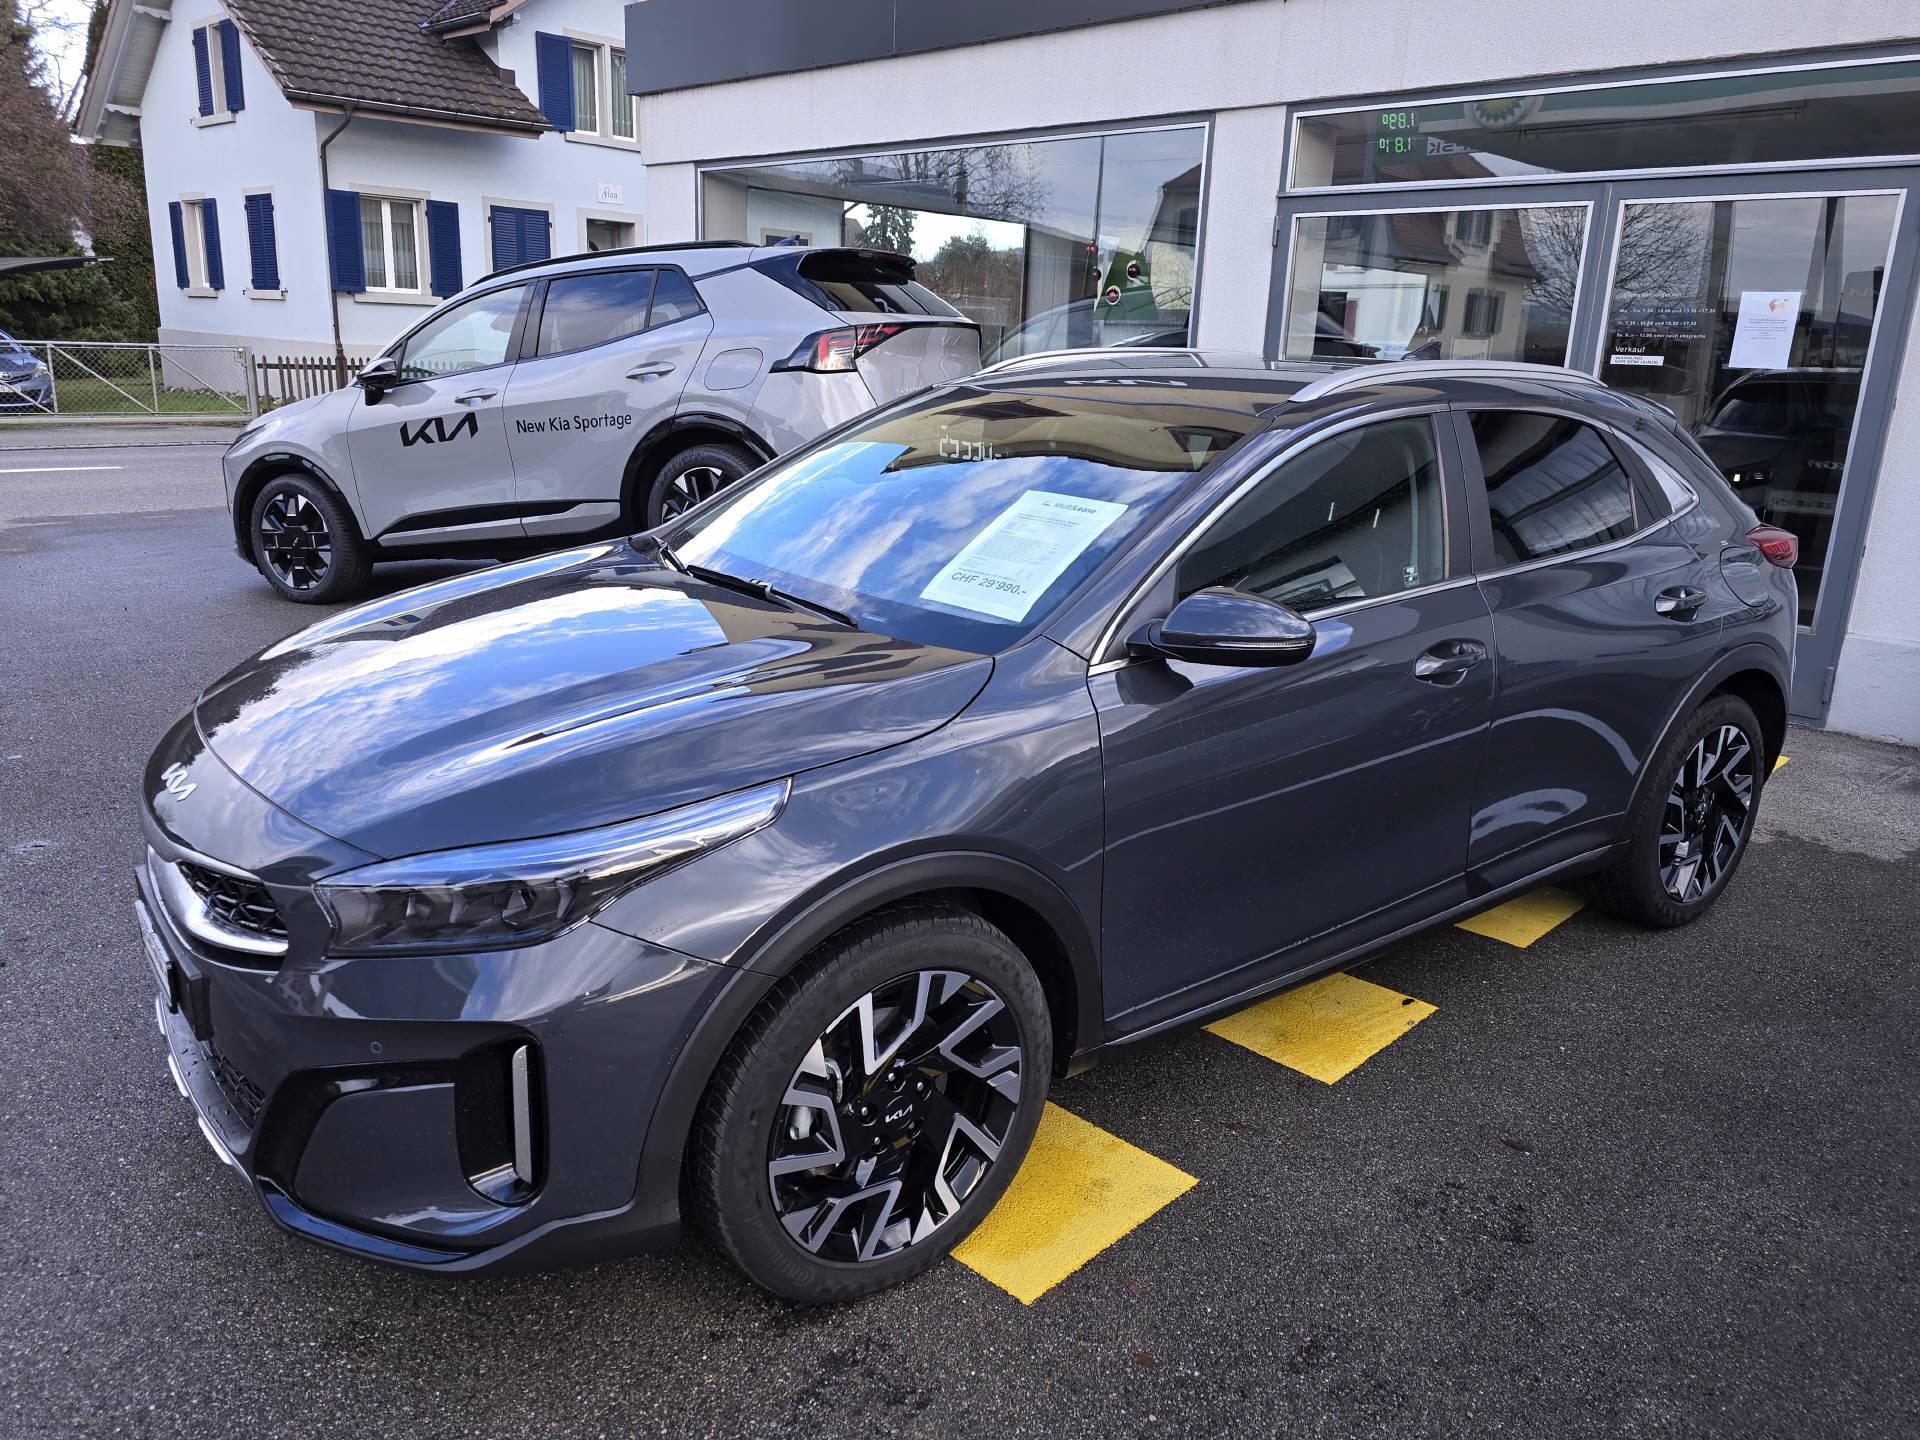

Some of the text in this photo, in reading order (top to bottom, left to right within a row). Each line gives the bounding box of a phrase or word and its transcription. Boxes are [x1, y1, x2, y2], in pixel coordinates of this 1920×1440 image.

[1615, 345, 1646, 353] Verkauf
[399, 411, 479, 447] KIA
[516, 412, 633, 434] New Kia Sportage
[951, 572, 979, 585] CHF
[885, 1103, 913, 1123] KIA
